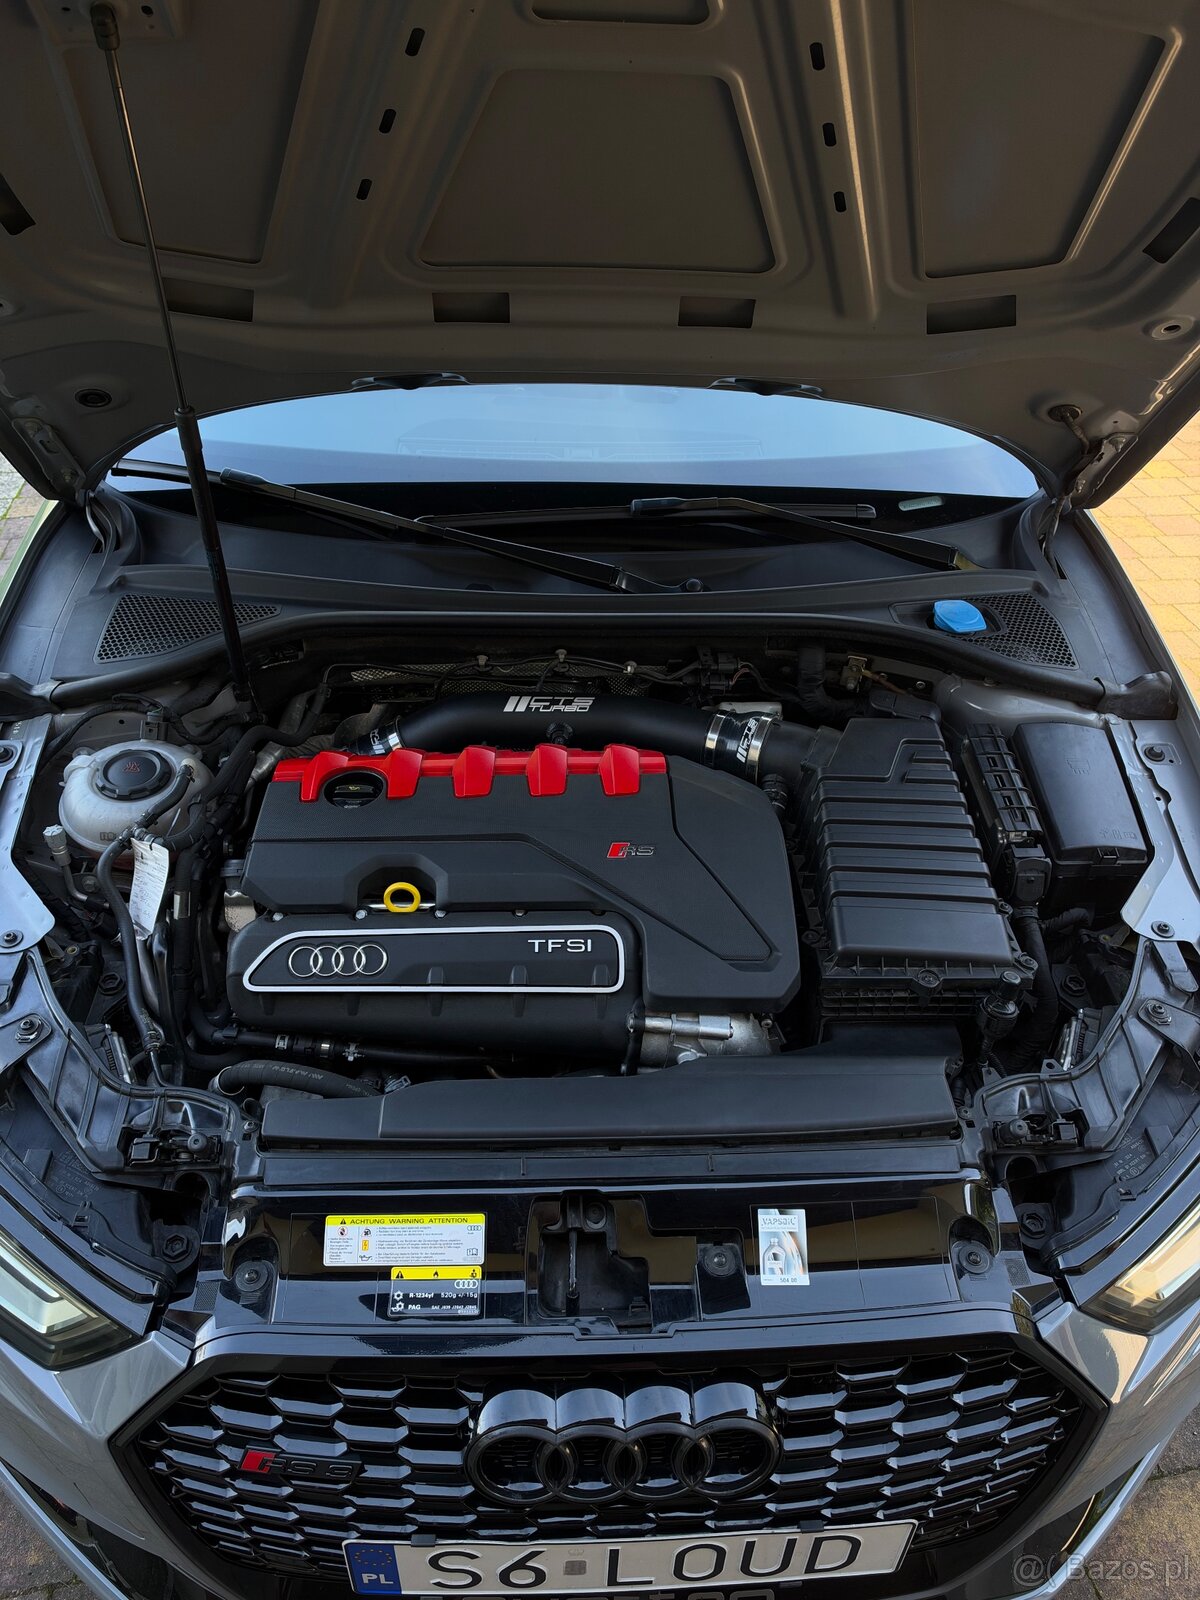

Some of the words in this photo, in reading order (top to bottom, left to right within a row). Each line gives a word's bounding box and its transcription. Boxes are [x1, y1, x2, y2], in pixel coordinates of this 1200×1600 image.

[529, 696, 595, 706] CTS
[528, 704, 590, 712] TURBO
[527, 938, 592, 953] TFSI
[427, 1548, 547, 1590] S6
[606, 1534, 863, 1587] LOUD
[361, 1573, 394, 1585] PL
